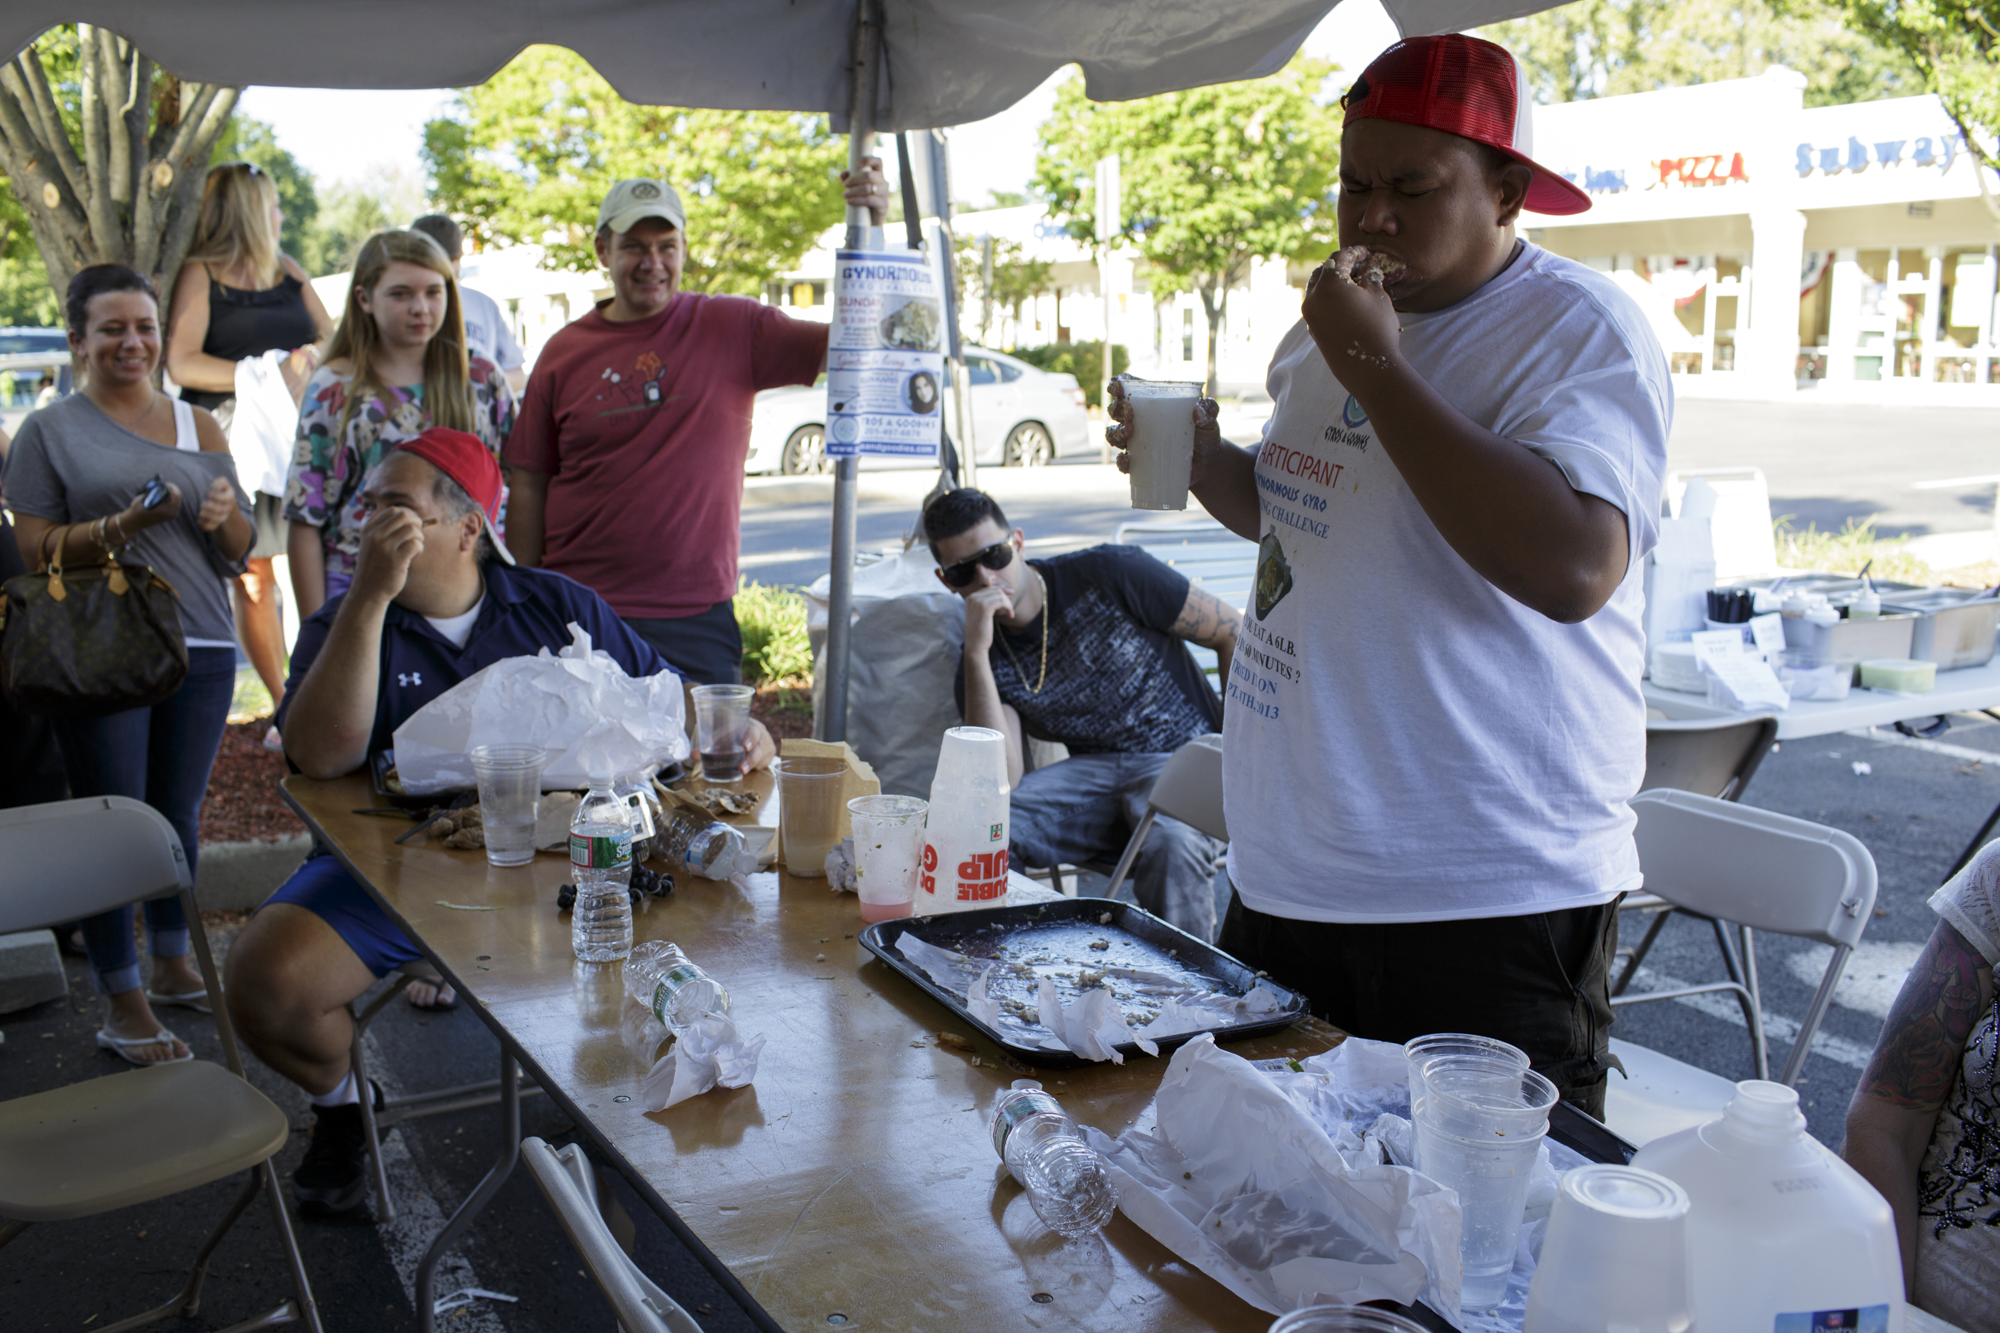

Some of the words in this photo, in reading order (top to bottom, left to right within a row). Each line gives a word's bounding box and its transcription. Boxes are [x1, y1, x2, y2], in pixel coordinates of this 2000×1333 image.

[1795, 135, 1966, 178] Subway
[1651, 152, 1750, 186] PIZZA
[842, 266, 931, 284] GYNORMOUS
[1302, 493, 1327, 513] GYRO
[1272, 505, 1330, 539] CHALLENGE
[1253, 622, 1266, 642] EAT
[1265, 632, 1274, 646] A
[1227, 681, 1238, 699] PT.
[1258, 678, 1278, 695] ON
